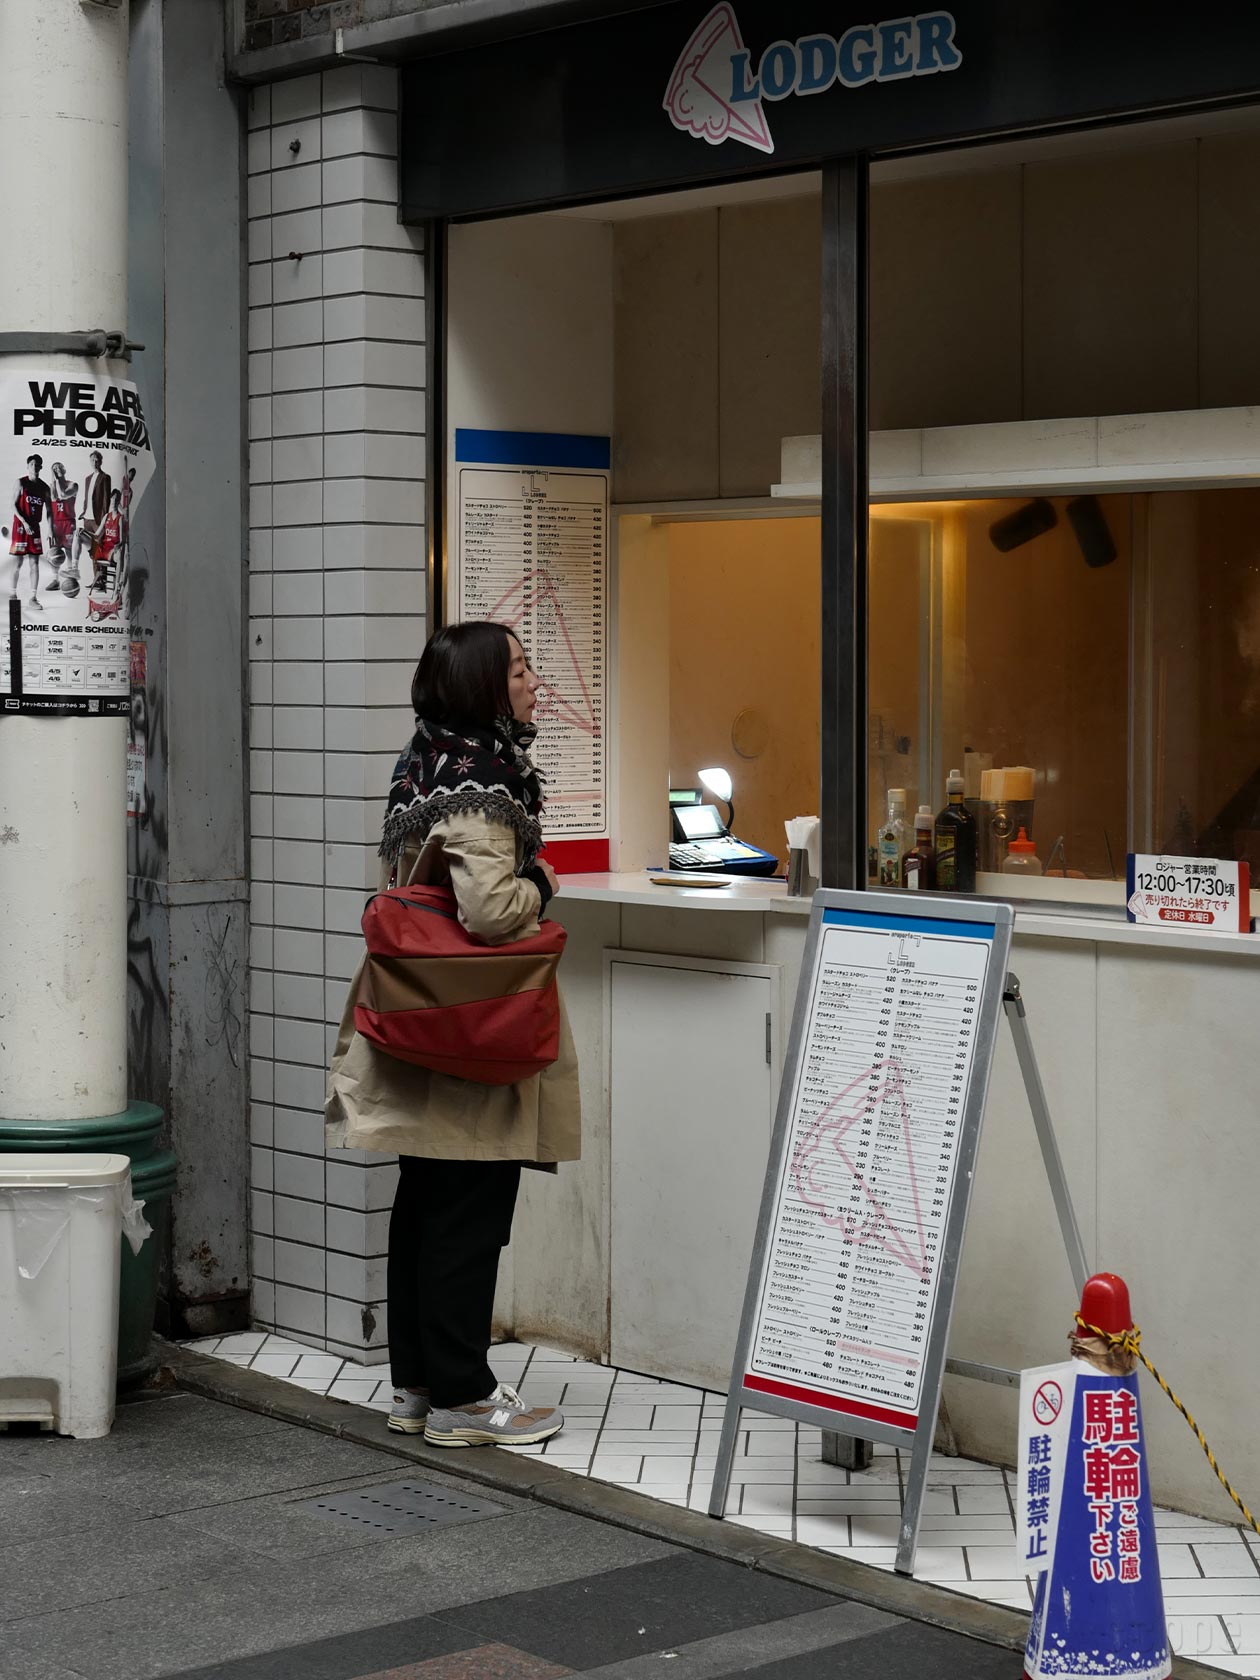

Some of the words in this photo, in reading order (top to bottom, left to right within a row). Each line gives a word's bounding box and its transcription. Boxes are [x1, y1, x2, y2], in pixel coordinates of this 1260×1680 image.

[729, 13, 960, 103] LODGER
[28, 381, 96, 410] WE
[69, 440, 109, 449] SAN-EN
[20, 624, 49, 632] HOME
[52, 625, 83, 633] GAME
[85, 626, 124, 634] SCHEDULE
[1156, 862, 1217, 876] ロジャー営業時間
[1145, 894, 1230, 911] 売り切れたら終了です
[1164, 909, 1185, 920] 定休日
[1188, 912, 1209, 922] 水曜日
[858, 1139, 869, 1147] 340
[939, 1153, 951, 1161] 340
[850, 1183, 862, 1191] 300
[924, 1243, 936, 1251] 470
[840, 1249, 851, 1257] 470
[922, 1254, 934, 1262] 470
[920, 1266, 932, 1274] 500
[832, 1294, 843, 1302] 420
[830, 1305, 842, 1313] 400
[825, 1338, 836, 1346] 520
[1083, 1388, 1140, 1501] 駐輪
[1026, 1433, 1052, 1560] 駐輪禁止
[1088, 1503, 1114, 1583] 下さい
[1119, 1503, 1141, 1583] ご遠慮
